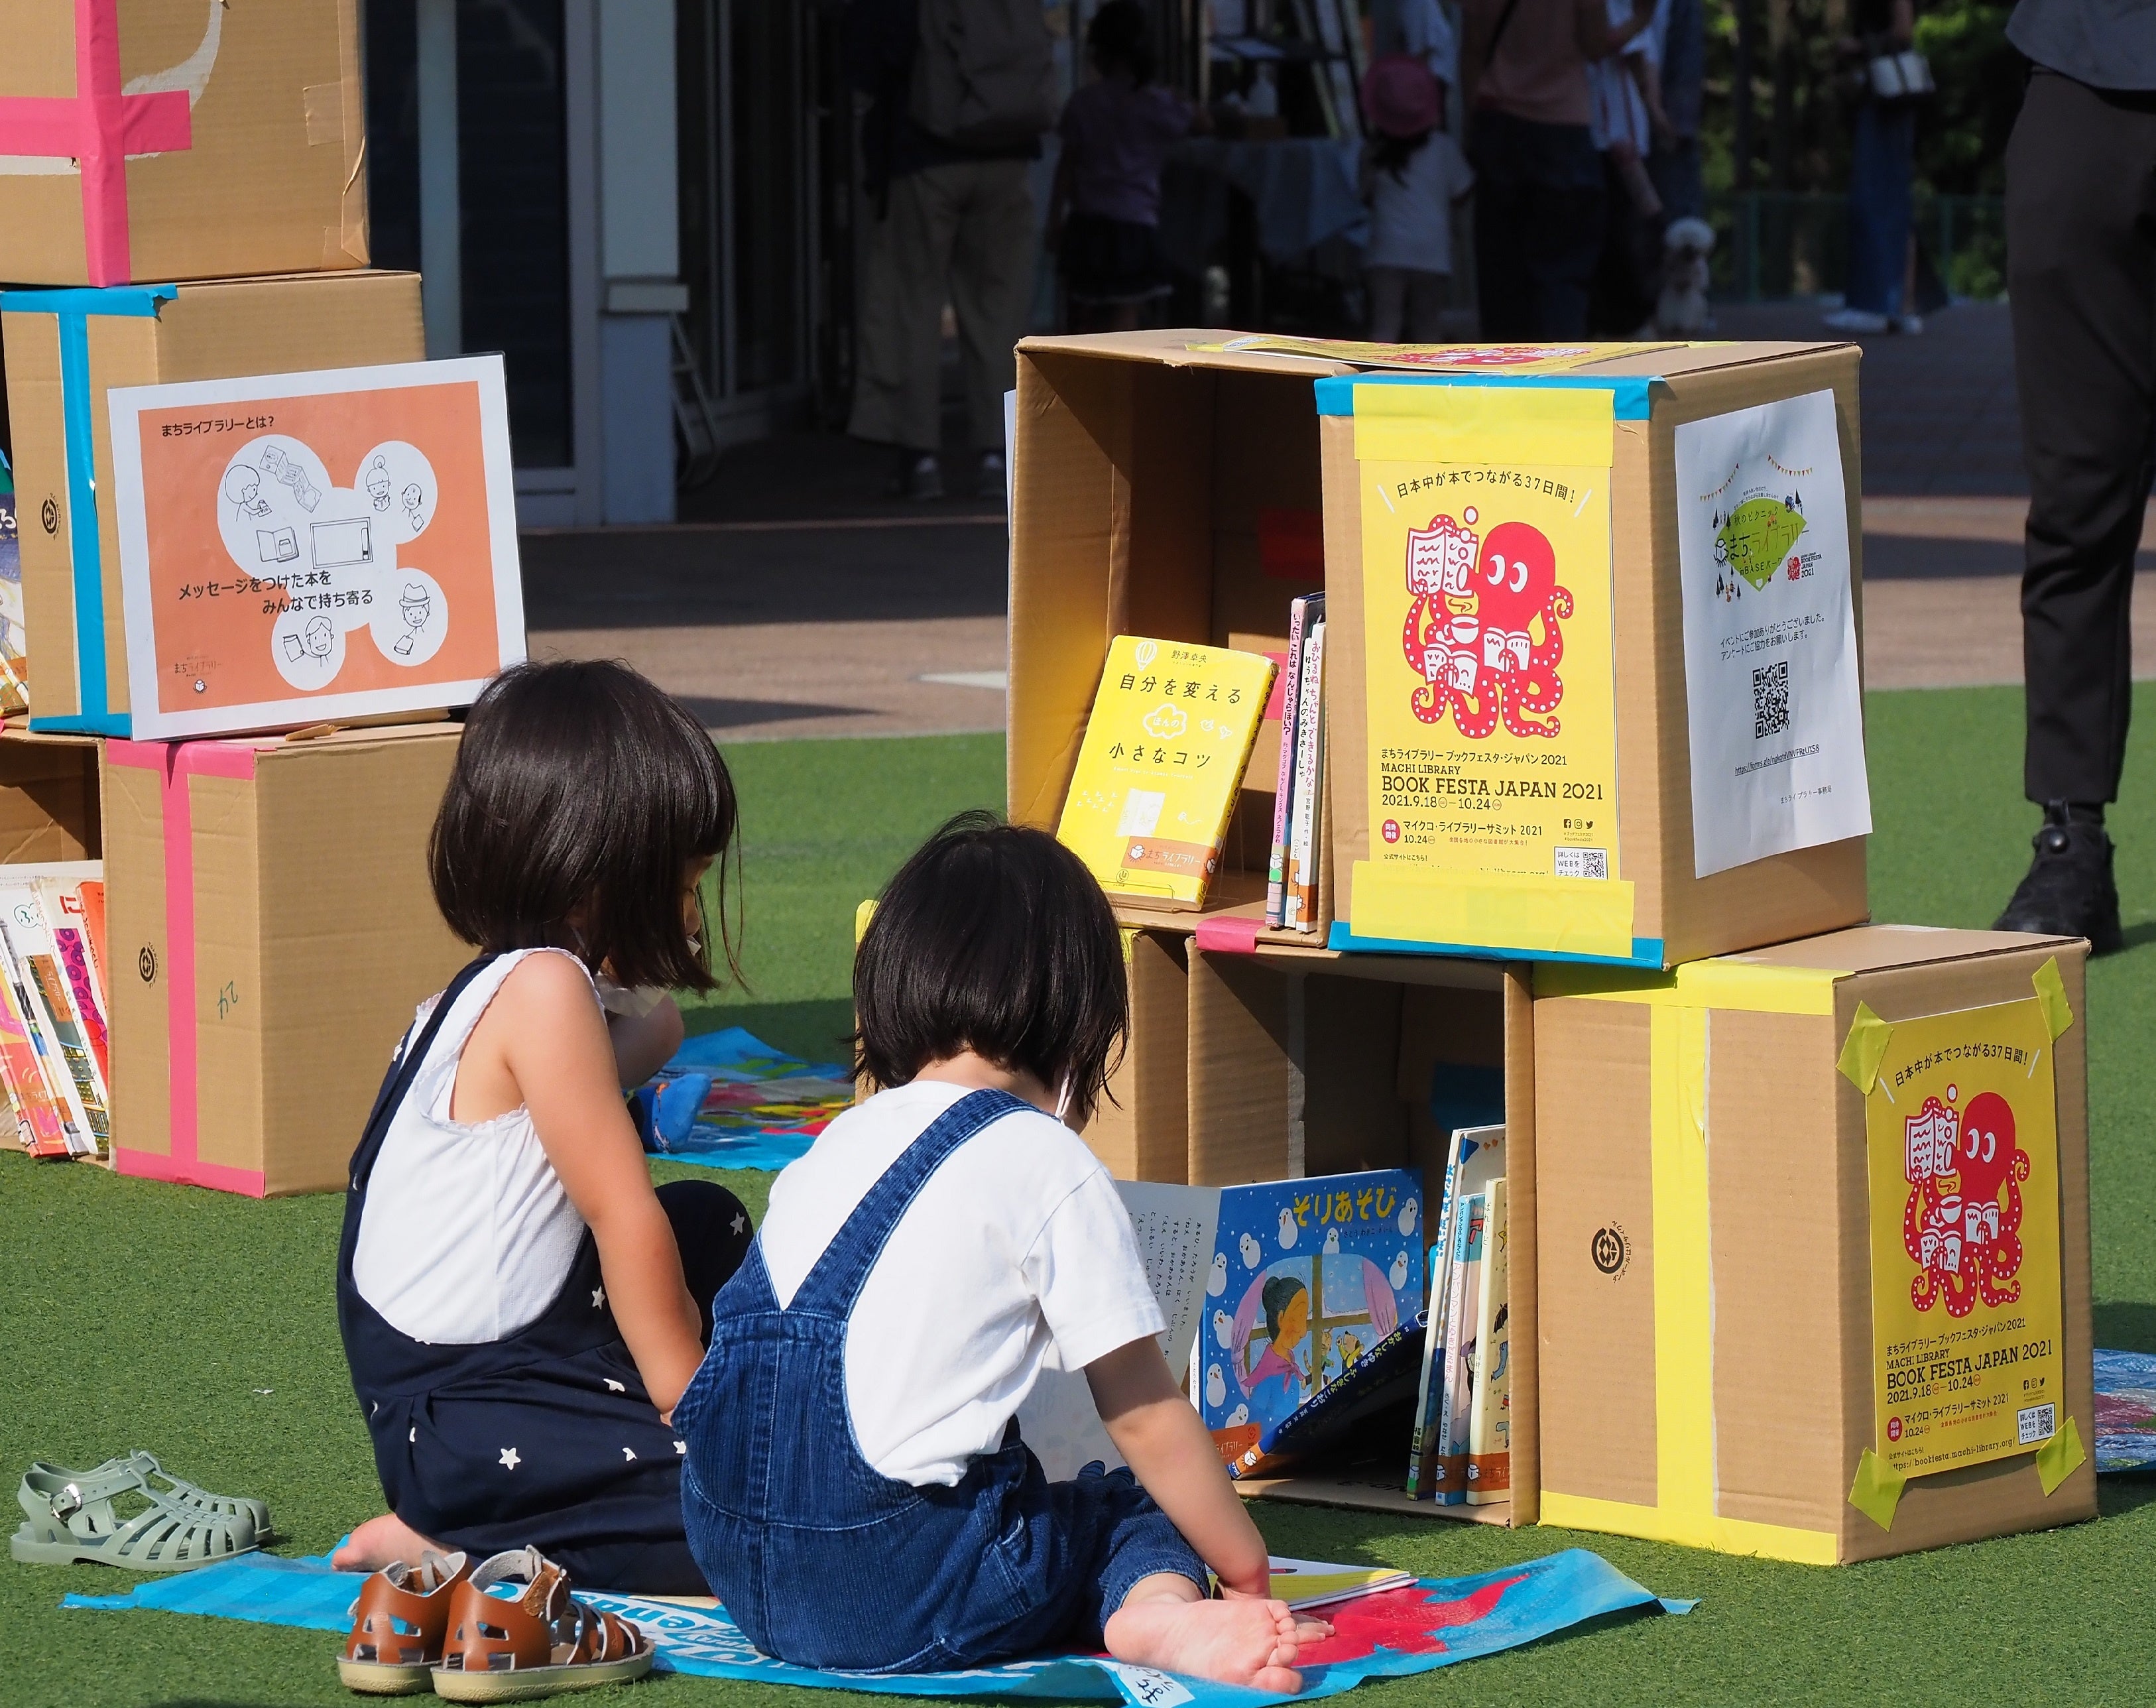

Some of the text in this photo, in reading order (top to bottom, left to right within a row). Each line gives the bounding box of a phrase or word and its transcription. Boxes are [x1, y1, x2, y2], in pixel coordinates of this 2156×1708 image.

[162, 416, 274, 437] まちライブラリーとは?
[1398, 469, 1575, 503] 日本中が本でつながる37日間!
[1730, 522, 1809, 560] まちライブラリー
[179, 571, 331, 599] メッセージをつけた本を
[1801, 568, 1814, 578] 2021
[263, 589, 373, 615] みんなで持ち寄る
[1291, 613, 1301, 640] いったい
[1720, 613, 1825, 648] イベントにご参加ありがとうございました。
[1289, 644, 1298, 668] これは
[1120, 673, 1240, 703] 自分を変える
[1109, 743, 1211, 768] 小さなコツ
[1382, 748, 1567, 766] まちライブラリー ブックフェスタ・ジャパン 2021
[1382, 763, 1461, 775] MACHI LIBRARY
[1382, 775, 1603, 800] BOOK FESTA JAPAN 2021
[1382, 794, 1437, 808] 2021.9.18
[1458, 798, 1491, 811] 10.24
[1403, 820, 1543, 835] マイクロ・ライブラリーサミット 2021
[1404, 835, 1427, 844] 10.24
[1895, 1042, 2028, 1087] 日本中が本でつながる37日間!
[1293, 1186, 1396, 1227] そりあそび
[1887, 1317, 2026, 1357] まちライブラリー ブックフェスタ・ジャパン 2021
[1886, 1348, 1950, 1370] MACHI LIBRARY
[1887, 1339, 2053, 1390] BOOK FESTA JAPAN 2021
[1887, 1375, 1974, 1405] 2021.9.18 10.24
[1904, 1392, 2009, 1424] マイクロ・ライブラリーサミット 2021
[1905, 1426, 1924, 1438] 10.24
[1215, 1440, 1243, 1455] ライブラリー
[1893, 1436, 2015, 1471] ttps://bookfesta.machi-library.org/
